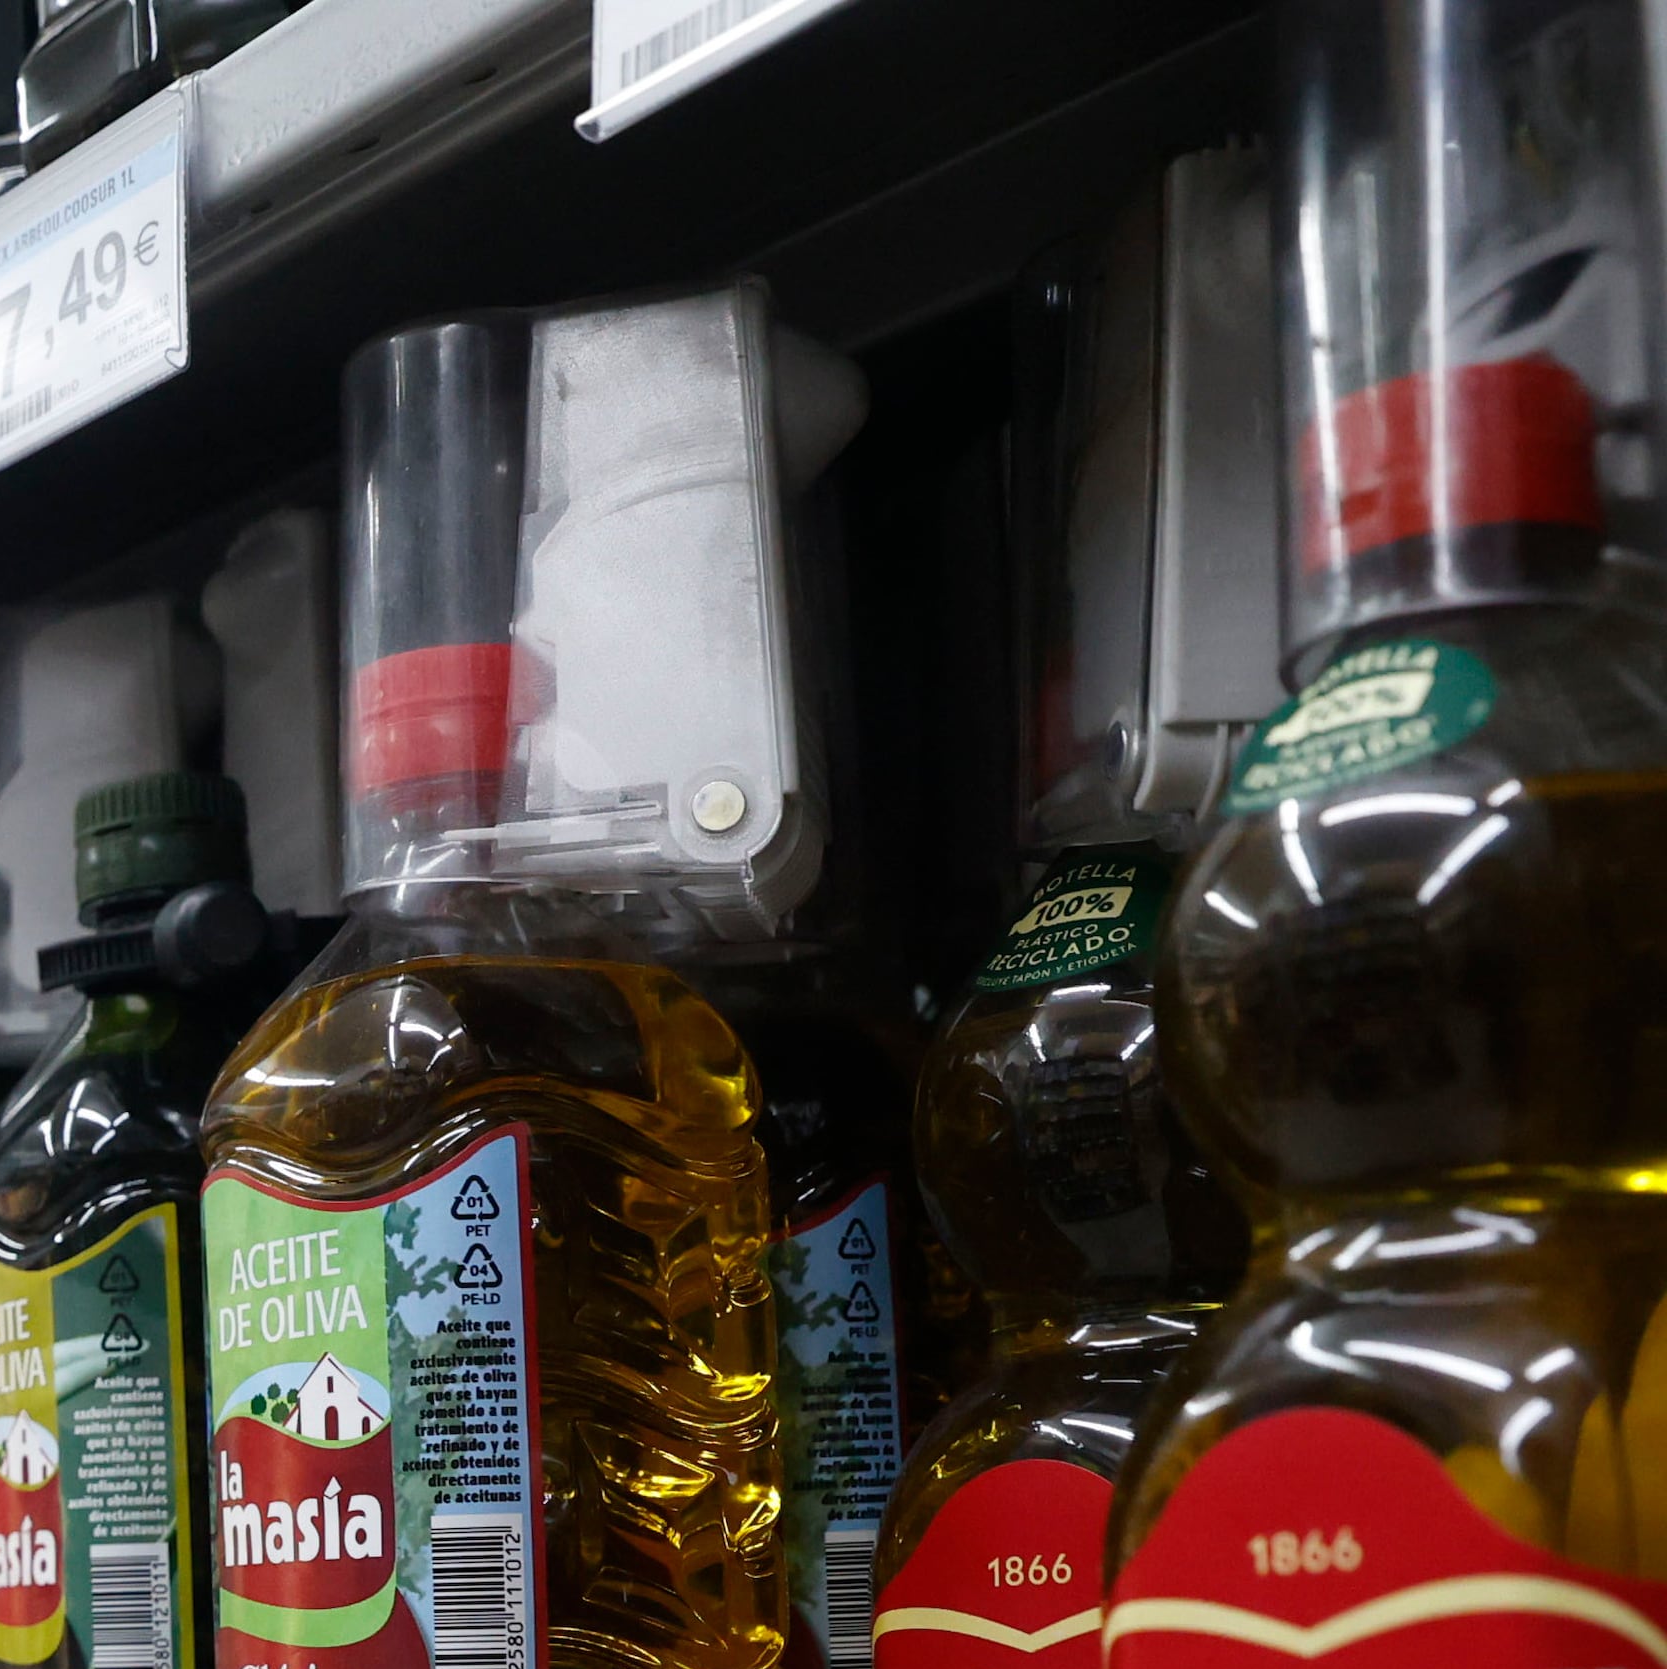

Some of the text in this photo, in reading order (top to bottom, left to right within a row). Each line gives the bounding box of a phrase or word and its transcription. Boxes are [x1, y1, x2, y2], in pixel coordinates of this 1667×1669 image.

[1034, 892, 1115, 926] 100%
[1068, 942, 1137, 972] ETIQUETA
[467, 1195, 484, 1208] 01
[465, 1224, 491, 1237] PET
[230, 1229, 341, 1295] ACEITE
[470, 1265, 488, 1277] 04
[461, 1293, 501, 1306] PE-LD
[219, 1285, 367, 1352] DE OLIVA
[436, 1319, 511, 1334] Aceite que
[456, 1335, 516, 1349] contiene
[410, 1353, 516, 1369] exclusivamente
[410, 1369, 516, 1386] aceites de oliva
[426, 1386, 517, 1405] que se hayan
[419, 1404, 518, 1420] sometido a un
[415, 1420, 519, 1437] tratamiento de
[426, 1437, 520, 1454] refinado y de
[402, 1454, 520, 1472] aceites obtenidos
[221, 1450, 243, 1501] la
[428, 1472, 521, 1487] directamente
[434, 1489, 521, 1504] de aceitunas
[1248, 1526, 1364, 1576] 1866
[988, 1553, 1072, 1588] 1866
